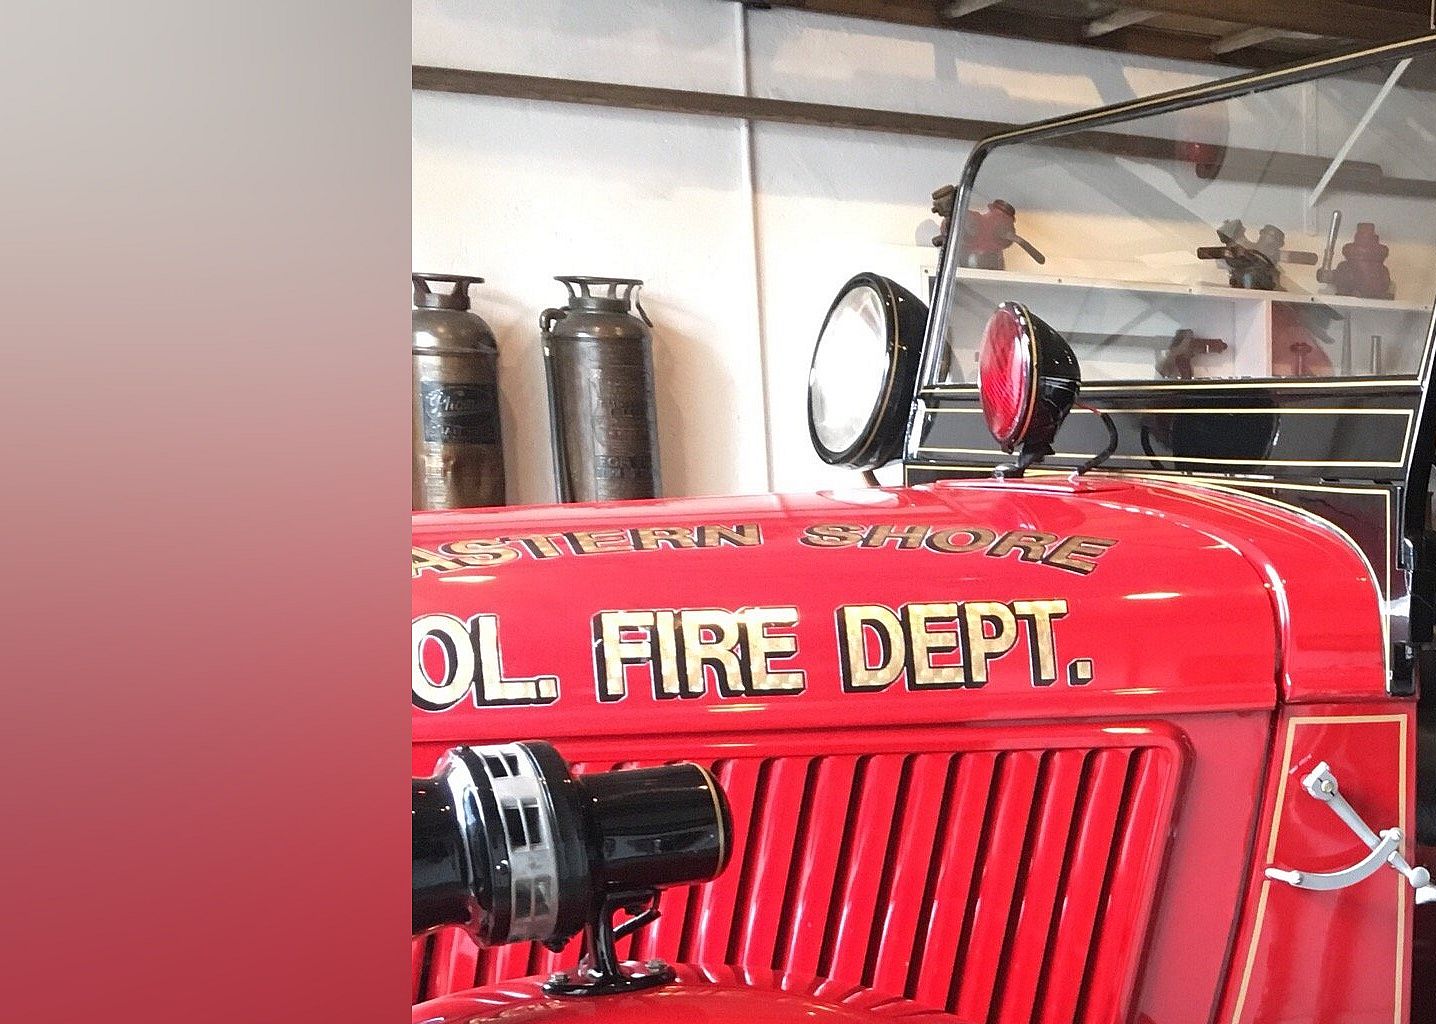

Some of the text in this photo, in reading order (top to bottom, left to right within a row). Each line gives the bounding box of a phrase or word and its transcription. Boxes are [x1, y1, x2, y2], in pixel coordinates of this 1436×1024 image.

[412, 523, 1118, 577] ASTERN SHORE
[412, 599, 1094, 712] OL. FIRE DEPT.
